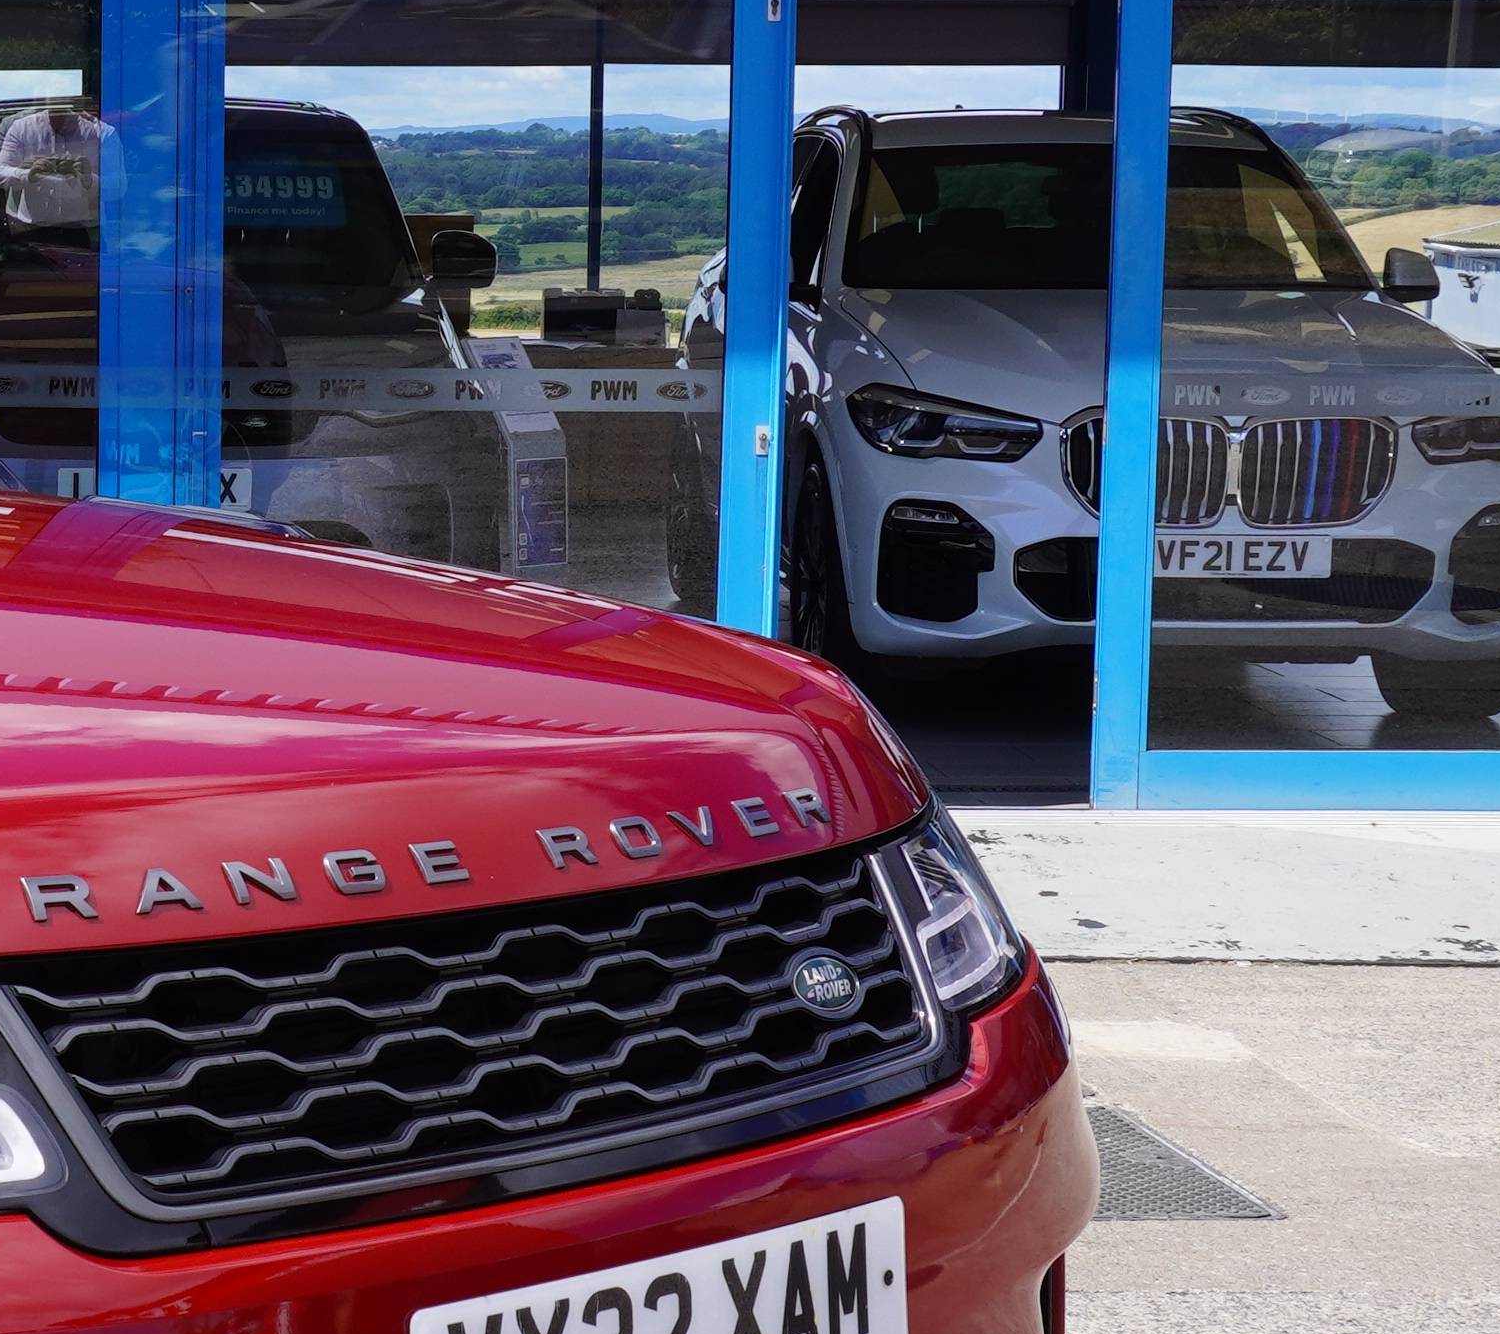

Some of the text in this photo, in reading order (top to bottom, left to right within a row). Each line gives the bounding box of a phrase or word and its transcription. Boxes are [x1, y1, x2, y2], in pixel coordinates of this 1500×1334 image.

[226, 206, 327, 218] Finance me today!
[48, 376, 95, 397] PWM
[258, 380, 294, 395] Ford
[590, 380, 638, 401] PWM
[1174, 384, 1221, 406] PWM
[1309, 384, 1356, 406] PWM
[1157, 539, 1310, 572] VF21 EZV
[18, 787, 835, 924] RANGE ROVER
[802, 964, 837, 986] LAND
[813, 978, 852, 1002] ROVER
